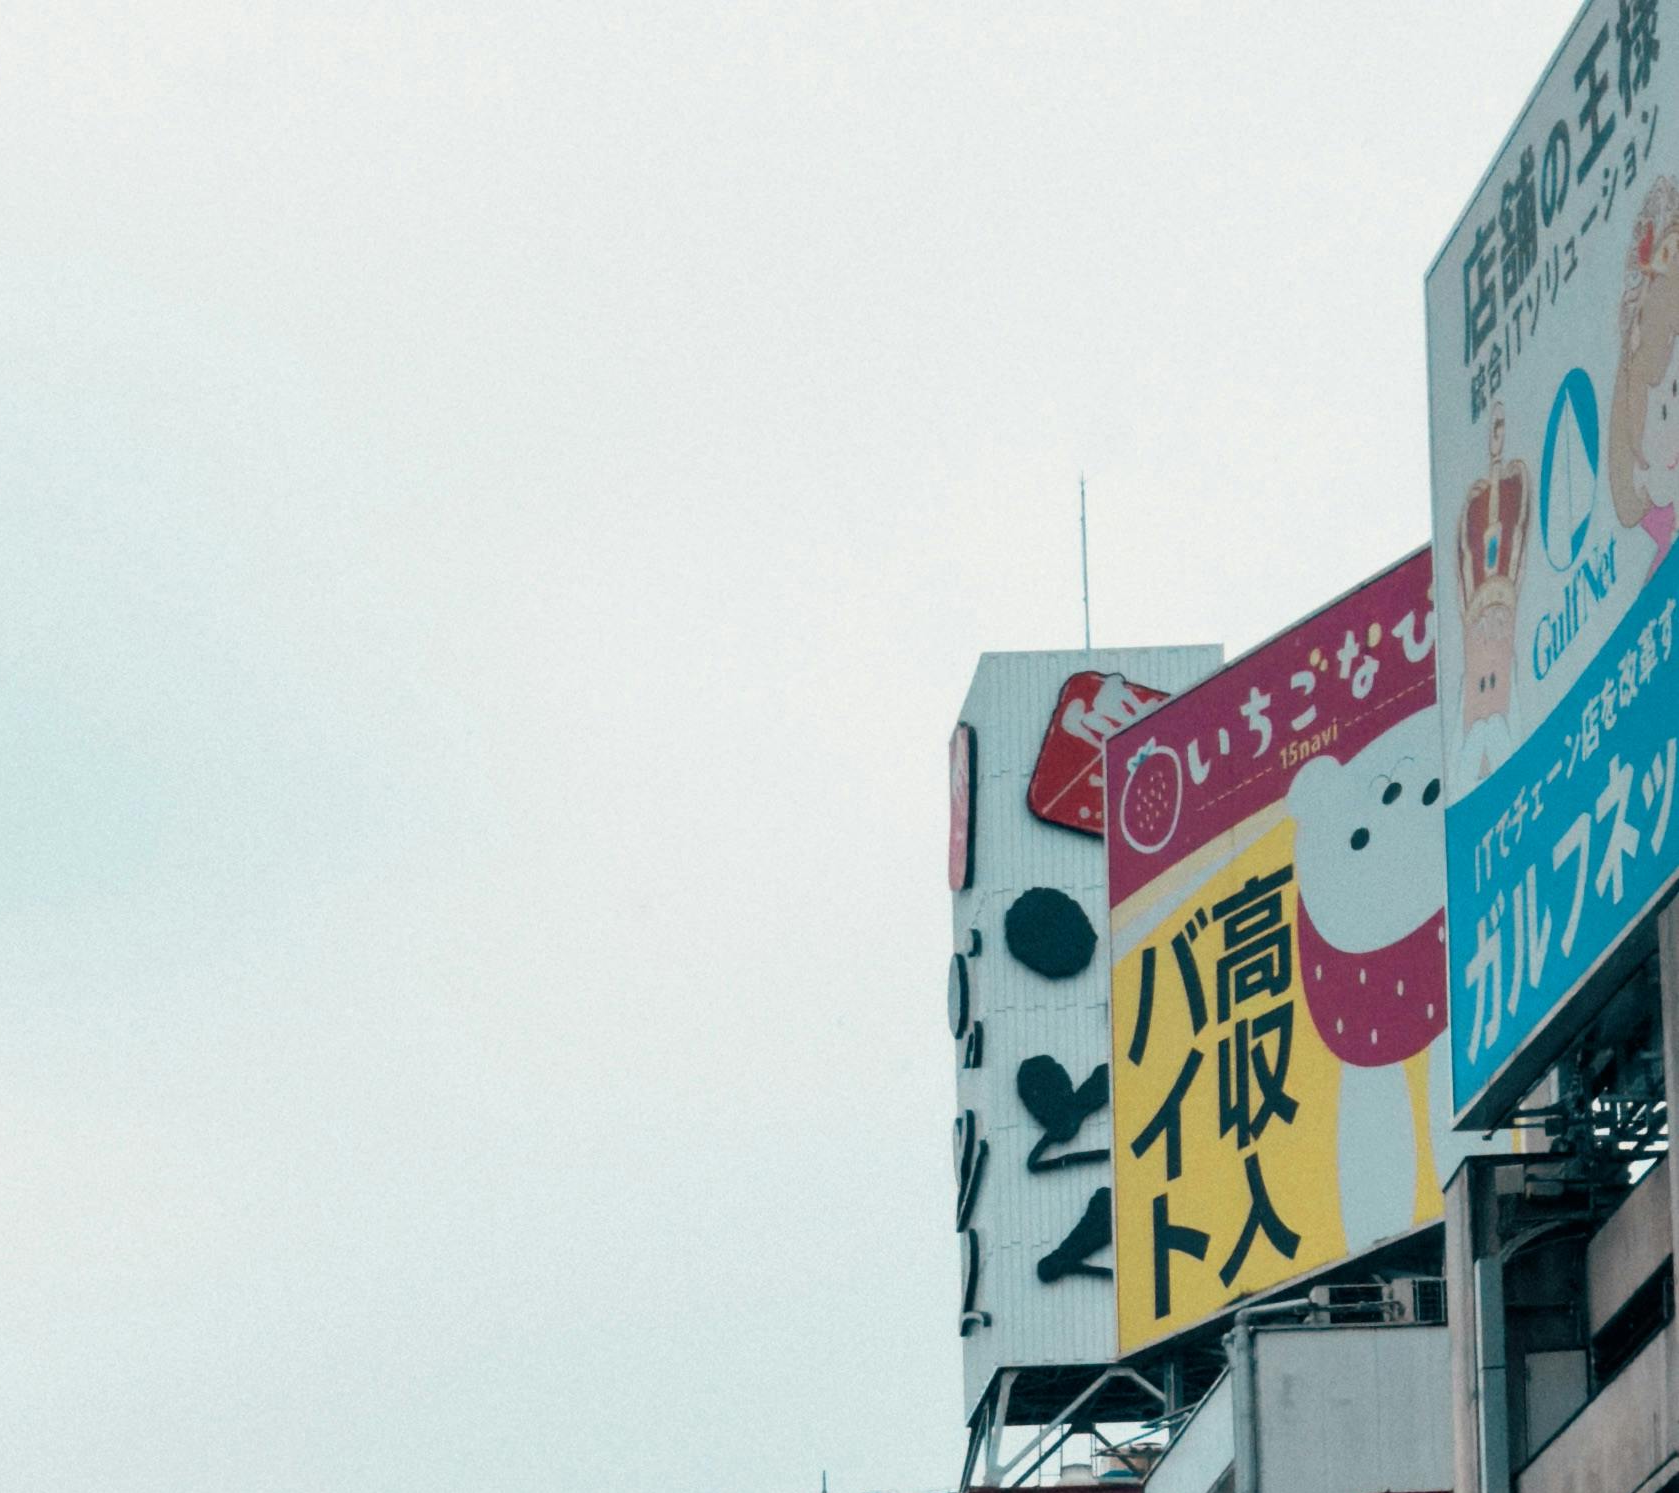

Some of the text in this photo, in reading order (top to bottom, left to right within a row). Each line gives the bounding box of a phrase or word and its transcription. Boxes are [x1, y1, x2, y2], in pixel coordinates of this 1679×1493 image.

[1280, 718, 1339, 770] 15navi
[1533, 538, 1618, 681] GulfNet
[1127, 907, 1212, 1320] バイト
[1211, 862, 1302, 1289] 高収入
